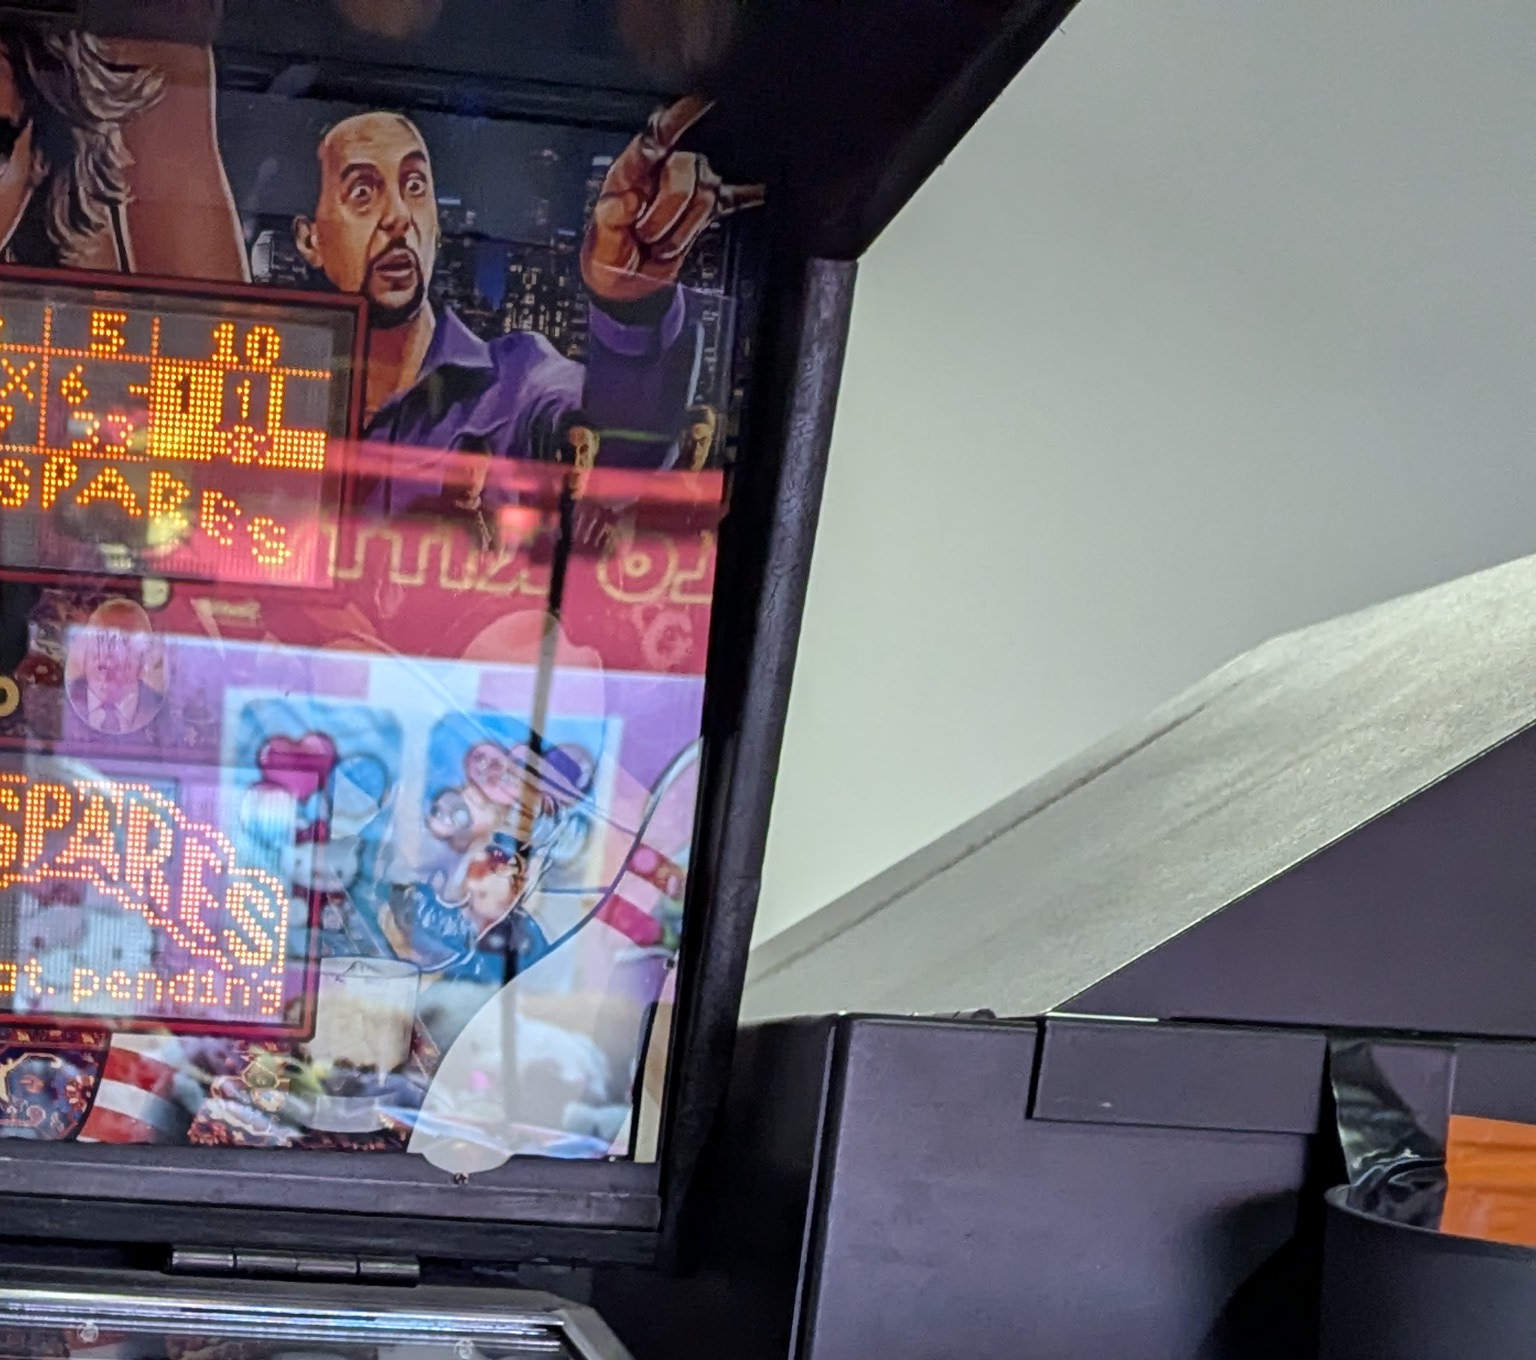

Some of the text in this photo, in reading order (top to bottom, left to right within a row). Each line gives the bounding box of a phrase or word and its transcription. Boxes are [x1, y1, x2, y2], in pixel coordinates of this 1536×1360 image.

[91, 310, 127, 353] 5
[213, 322, 281, 366] 10
[72, 967, 283, 1015] pending
